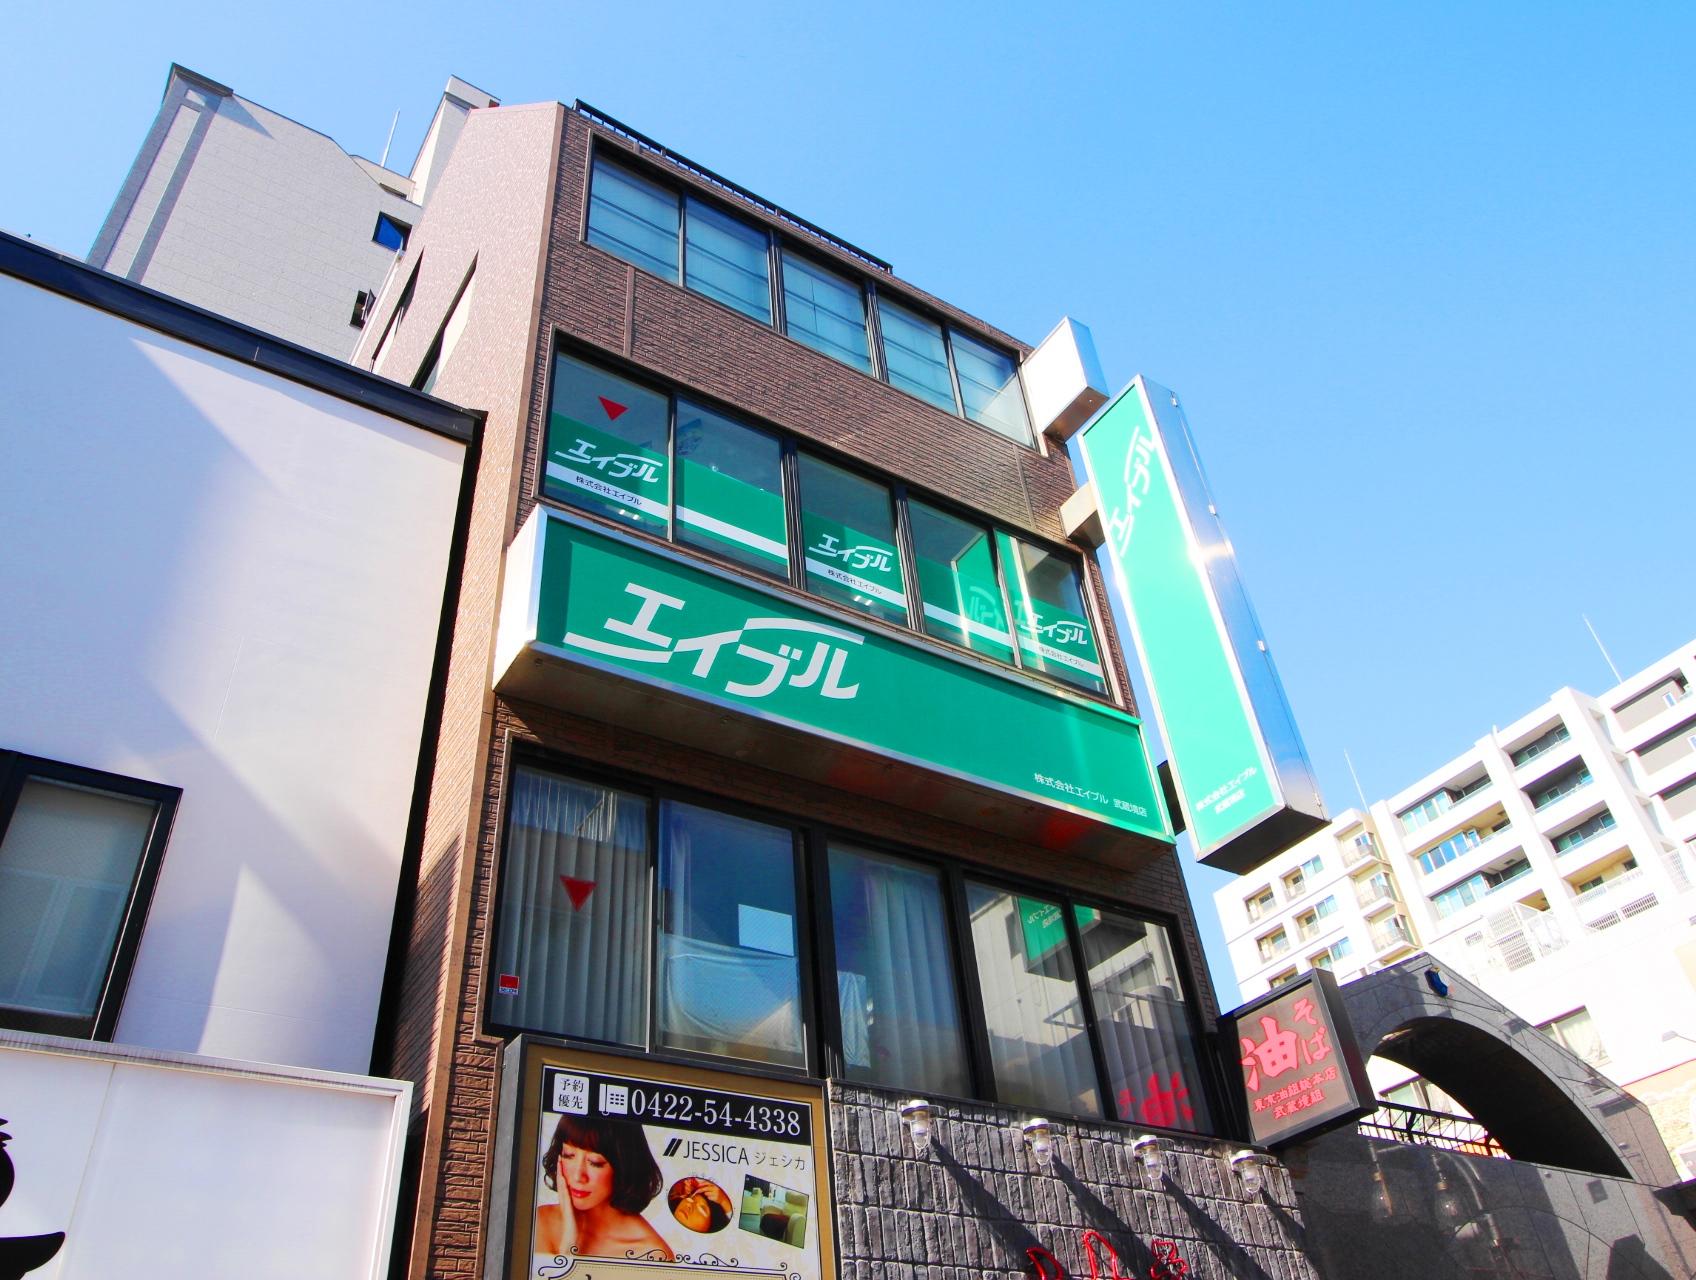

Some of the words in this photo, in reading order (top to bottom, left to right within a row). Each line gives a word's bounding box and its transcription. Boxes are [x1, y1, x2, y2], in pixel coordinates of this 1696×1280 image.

[555, 438, 664, 483] エイブル
[576, 475, 642, 506] 株式会社エイブル
[1109, 425, 1155, 559] エイブル
[809, 534, 893, 573] エイブル
[562, 582, 866, 699] エイブル
[1020, 612, 1088, 645] エイブル
[1034, 772, 1109, 805] 株式会社エイブル
[558, 1093, 583, 1110] 優先
[560, 1078, 584, 1093] 予約
[631, 1088, 800, 1136] 0422-54-4338
[683, 1140, 750, 1166] JESSICA
[754, 1151, 805, 1171] ジェシカ
